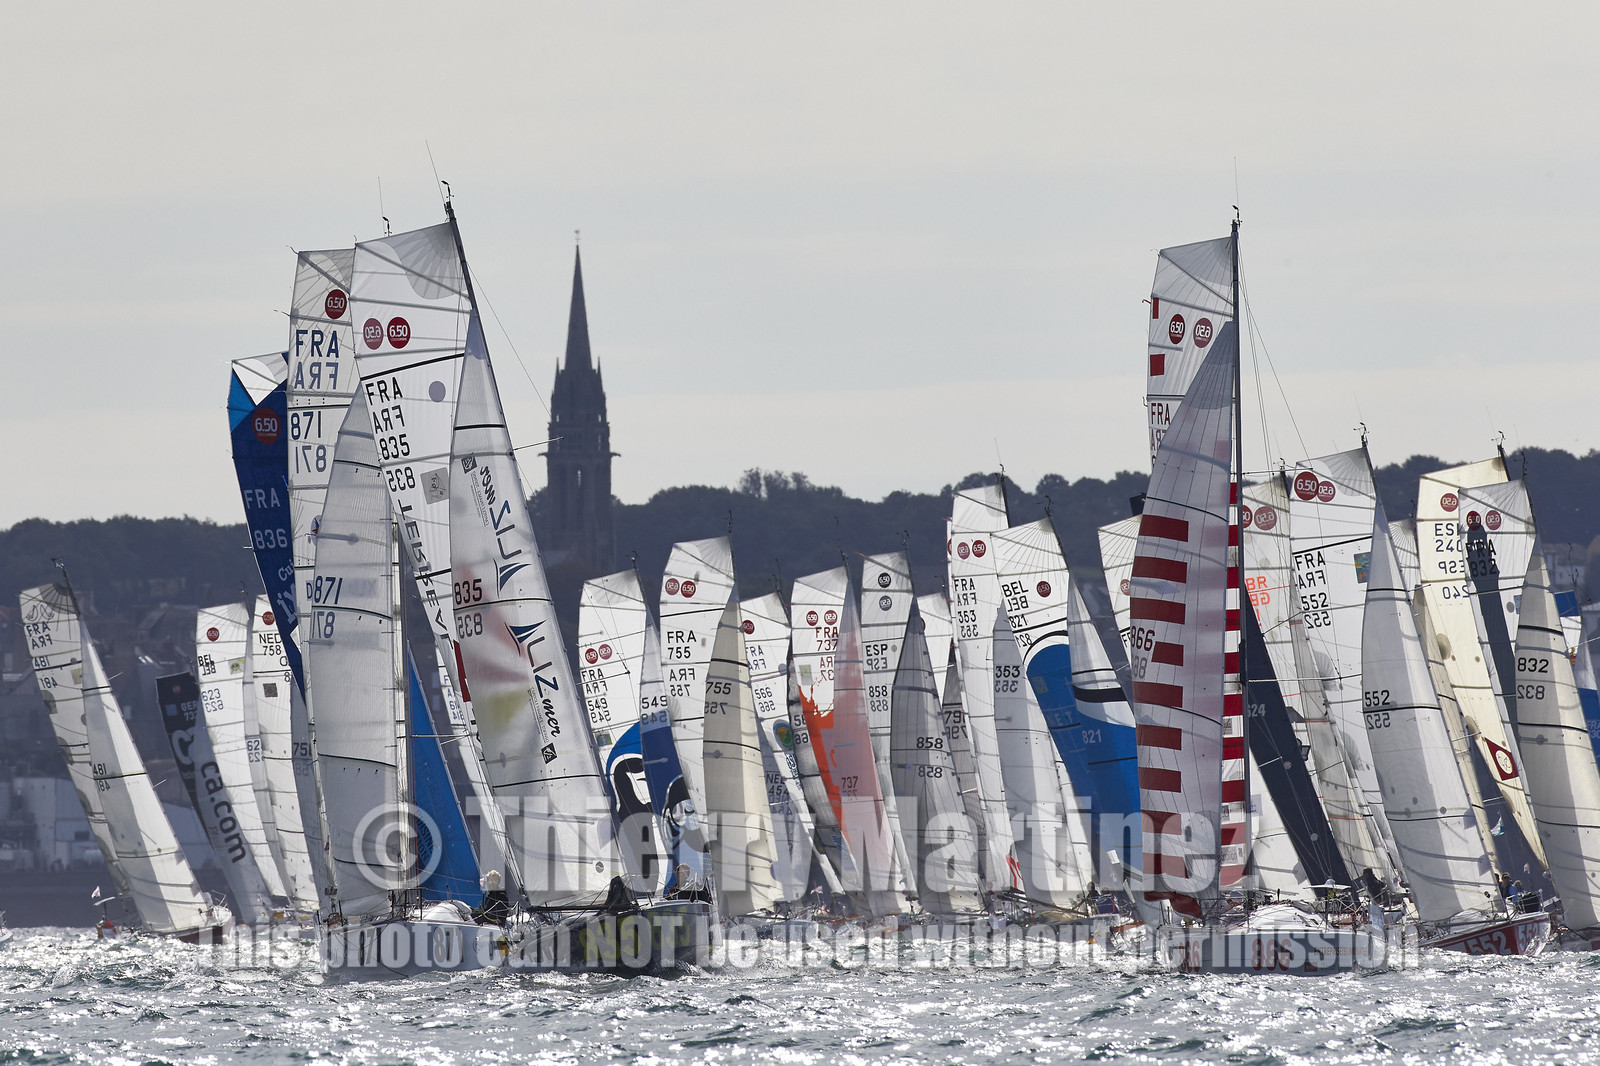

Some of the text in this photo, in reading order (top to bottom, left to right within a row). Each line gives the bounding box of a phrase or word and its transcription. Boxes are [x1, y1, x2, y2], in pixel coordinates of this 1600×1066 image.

[328, 298, 345, 309] 6.50
[389, 325, 408, 337] 6.50
[1170, 321, 1184, 334] 6.50
[296, 330, 340, 358] FRA
[365, 377, 403, 406] FRA
[1151, 403, 1171, 425] FRA
[254, 417, 278, 432] 6.50
[290, 411, 322, 441] 871
[379, 434, 410, 461] 835
[1296, 478, 1317, 492] 6.50
[244, 488, 281, 510] FRA
[254, 528, 287, 550] 836
[1465, 539, 1497, 558] FRA
[1294, 553, 1326, 571] FRA
[1470, 558, 1498, 579] 832
[314, 576, 343, 605] 871
[953, 578, 976, 592] FRA
[1001, 580, 1029, 598] BEL
[1245, 575, 1268, 592] BR
[454, 578, 482, 605] 835
[1300, 592, 1329, 611] 552
[957, 610, 977, 624] 353
[1009, 613, 1028, 630] 821
[26, 620, 51, 638] FRA
[667, 630, 697, 643] FRA
[815, 626, 839, 639] FRA
[259, 633, 282, 645] NED
[817, 639, 838, 652] 737
[263, 645, 282, 657] 758
[667, 646, 691, 660] 755
[746, 644, 764, 657] FRA
[865, 643, 888, 657] ESP
[34, 656, 50, 667] 481
[198, 655, 214, 667] BEL
[526, 636, 560, 699] LIZ
[1517, 657, 1549, 673] 832
[581, 668, 604, 683] FRA
[994, 665, 1021, 679] 353
[201, 688, 221, 702] 623
[705, 681, 732, 695] 755
[754, 686, 772, 700] 566
[868, 685, 888, 698] 858
[587, 697, 608, 712] 549
[641, 695, 668, 709] 549
[1364, 690, 1391, 707] 552
[541, 698, 561, 738] mer
[916, 736, 943, 750] 858
[1082, 728, 1102, 744] 821
[247, 739, 260, 752] 62
[93, 763, 106, 776] 481
[841, 775, 859, 789] 737
[768, 785, 790, 796] 454
[201, 761, 246, 864] ca.com
[433, 926, 464, 963] 871
[1251, 938, 1292, 971] 866
